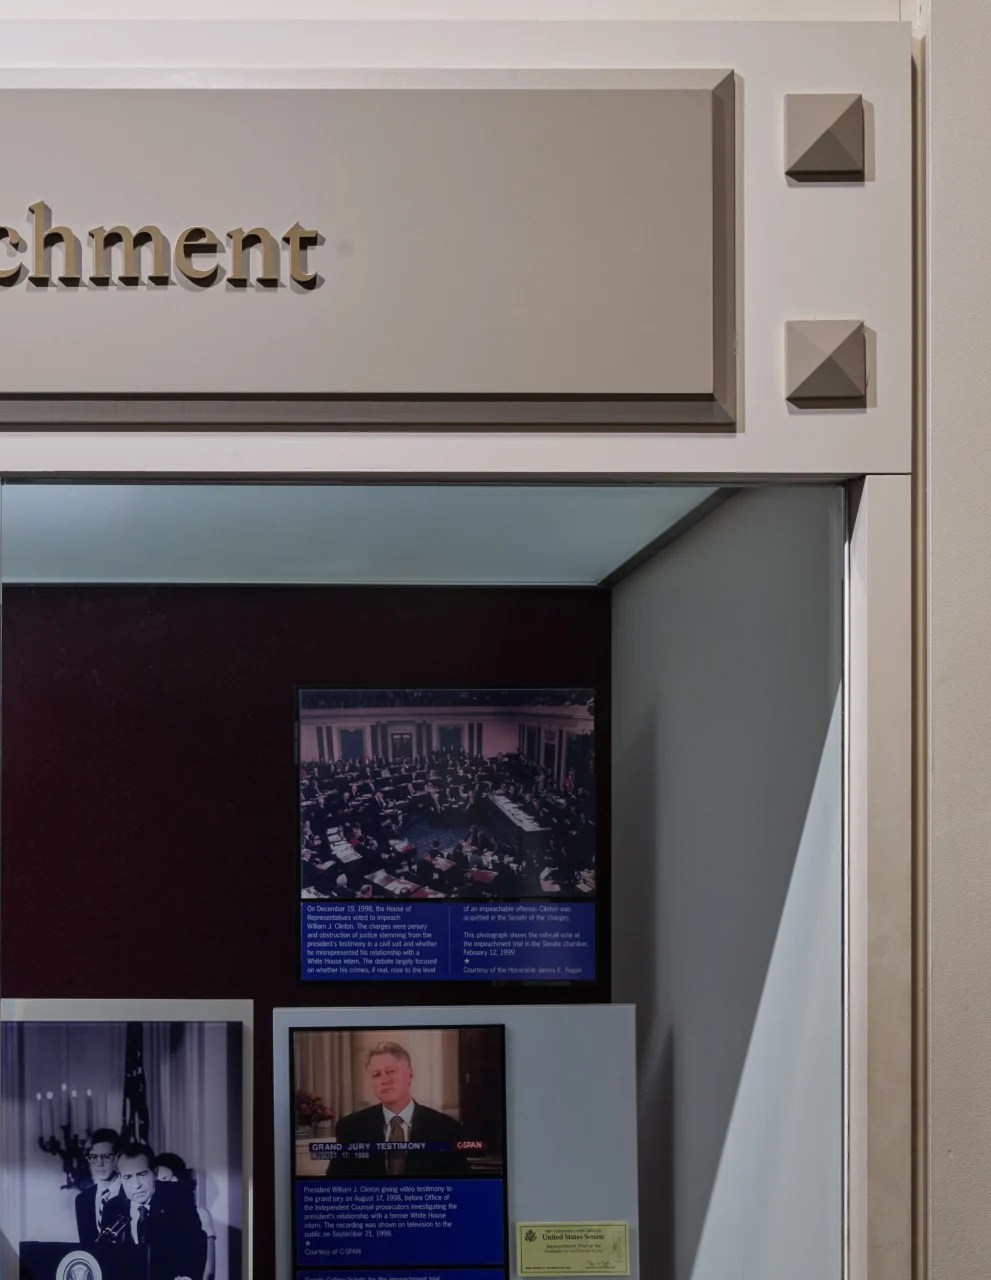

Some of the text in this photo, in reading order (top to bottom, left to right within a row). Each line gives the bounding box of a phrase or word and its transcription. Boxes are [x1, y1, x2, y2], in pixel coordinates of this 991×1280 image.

[347, 905, 356, 913] 19,
[358, 905, 374, 913] 1998,
[463, 948, 517, 958] February 12, 1999.
[457, 1141, 483, 1149] C-SPAN
